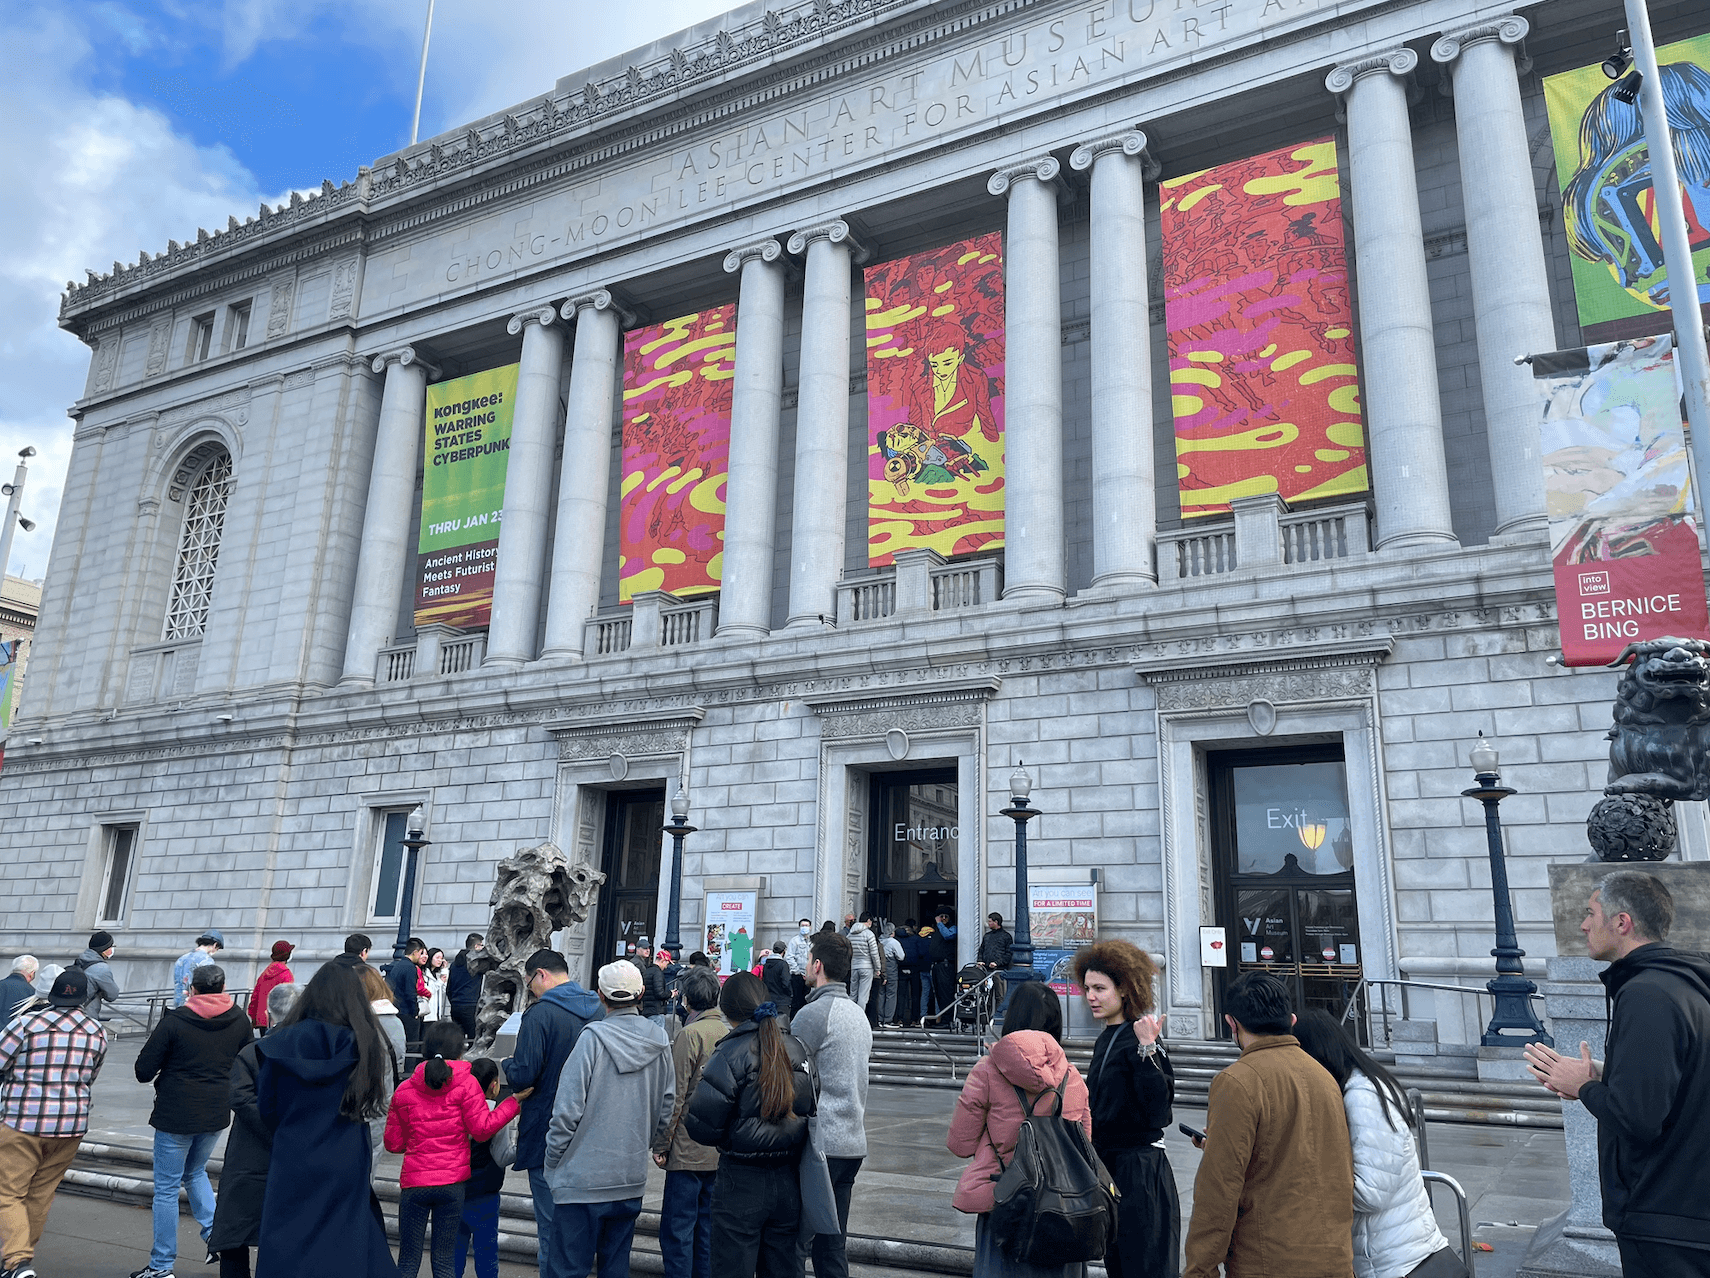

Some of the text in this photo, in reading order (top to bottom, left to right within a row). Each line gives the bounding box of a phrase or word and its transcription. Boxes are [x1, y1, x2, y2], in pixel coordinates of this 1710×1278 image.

[677, 0, 1206, 181] ASIAN ART MUSEU
[446, 197, 660, 283] CHONG-MOON
[677, 173, 727, 210] LEE
[745, 125, 884, 186] CENTER
[902, 95, 977, 138] FOR
[995, 40, 1126, 106] ASIAN
[1148, 3, 1234, 54] ART
[434, 411, 496, 436] WARRING
[434, 429, 482, 450] STATES
[433, 437, 510, 466] CYBERPUNK
[429, 518, 461, 536] THRU
[463, 512, 488, 529] JAN
[425, 552, 463, 569] Ancient
[424, 569, 452, 583] Meets
[1583, 575, 1602, 584] into
[422, 582, 461, 597] Fantasy
[1584, 582, 1607, 593] view
[1580, 594, 1682, 620] BERNICE
[1583, 619, 1639, 641] BING
[1266, 807, 1308, 829] Exit
[895, 822, 959, 842] Entranc
